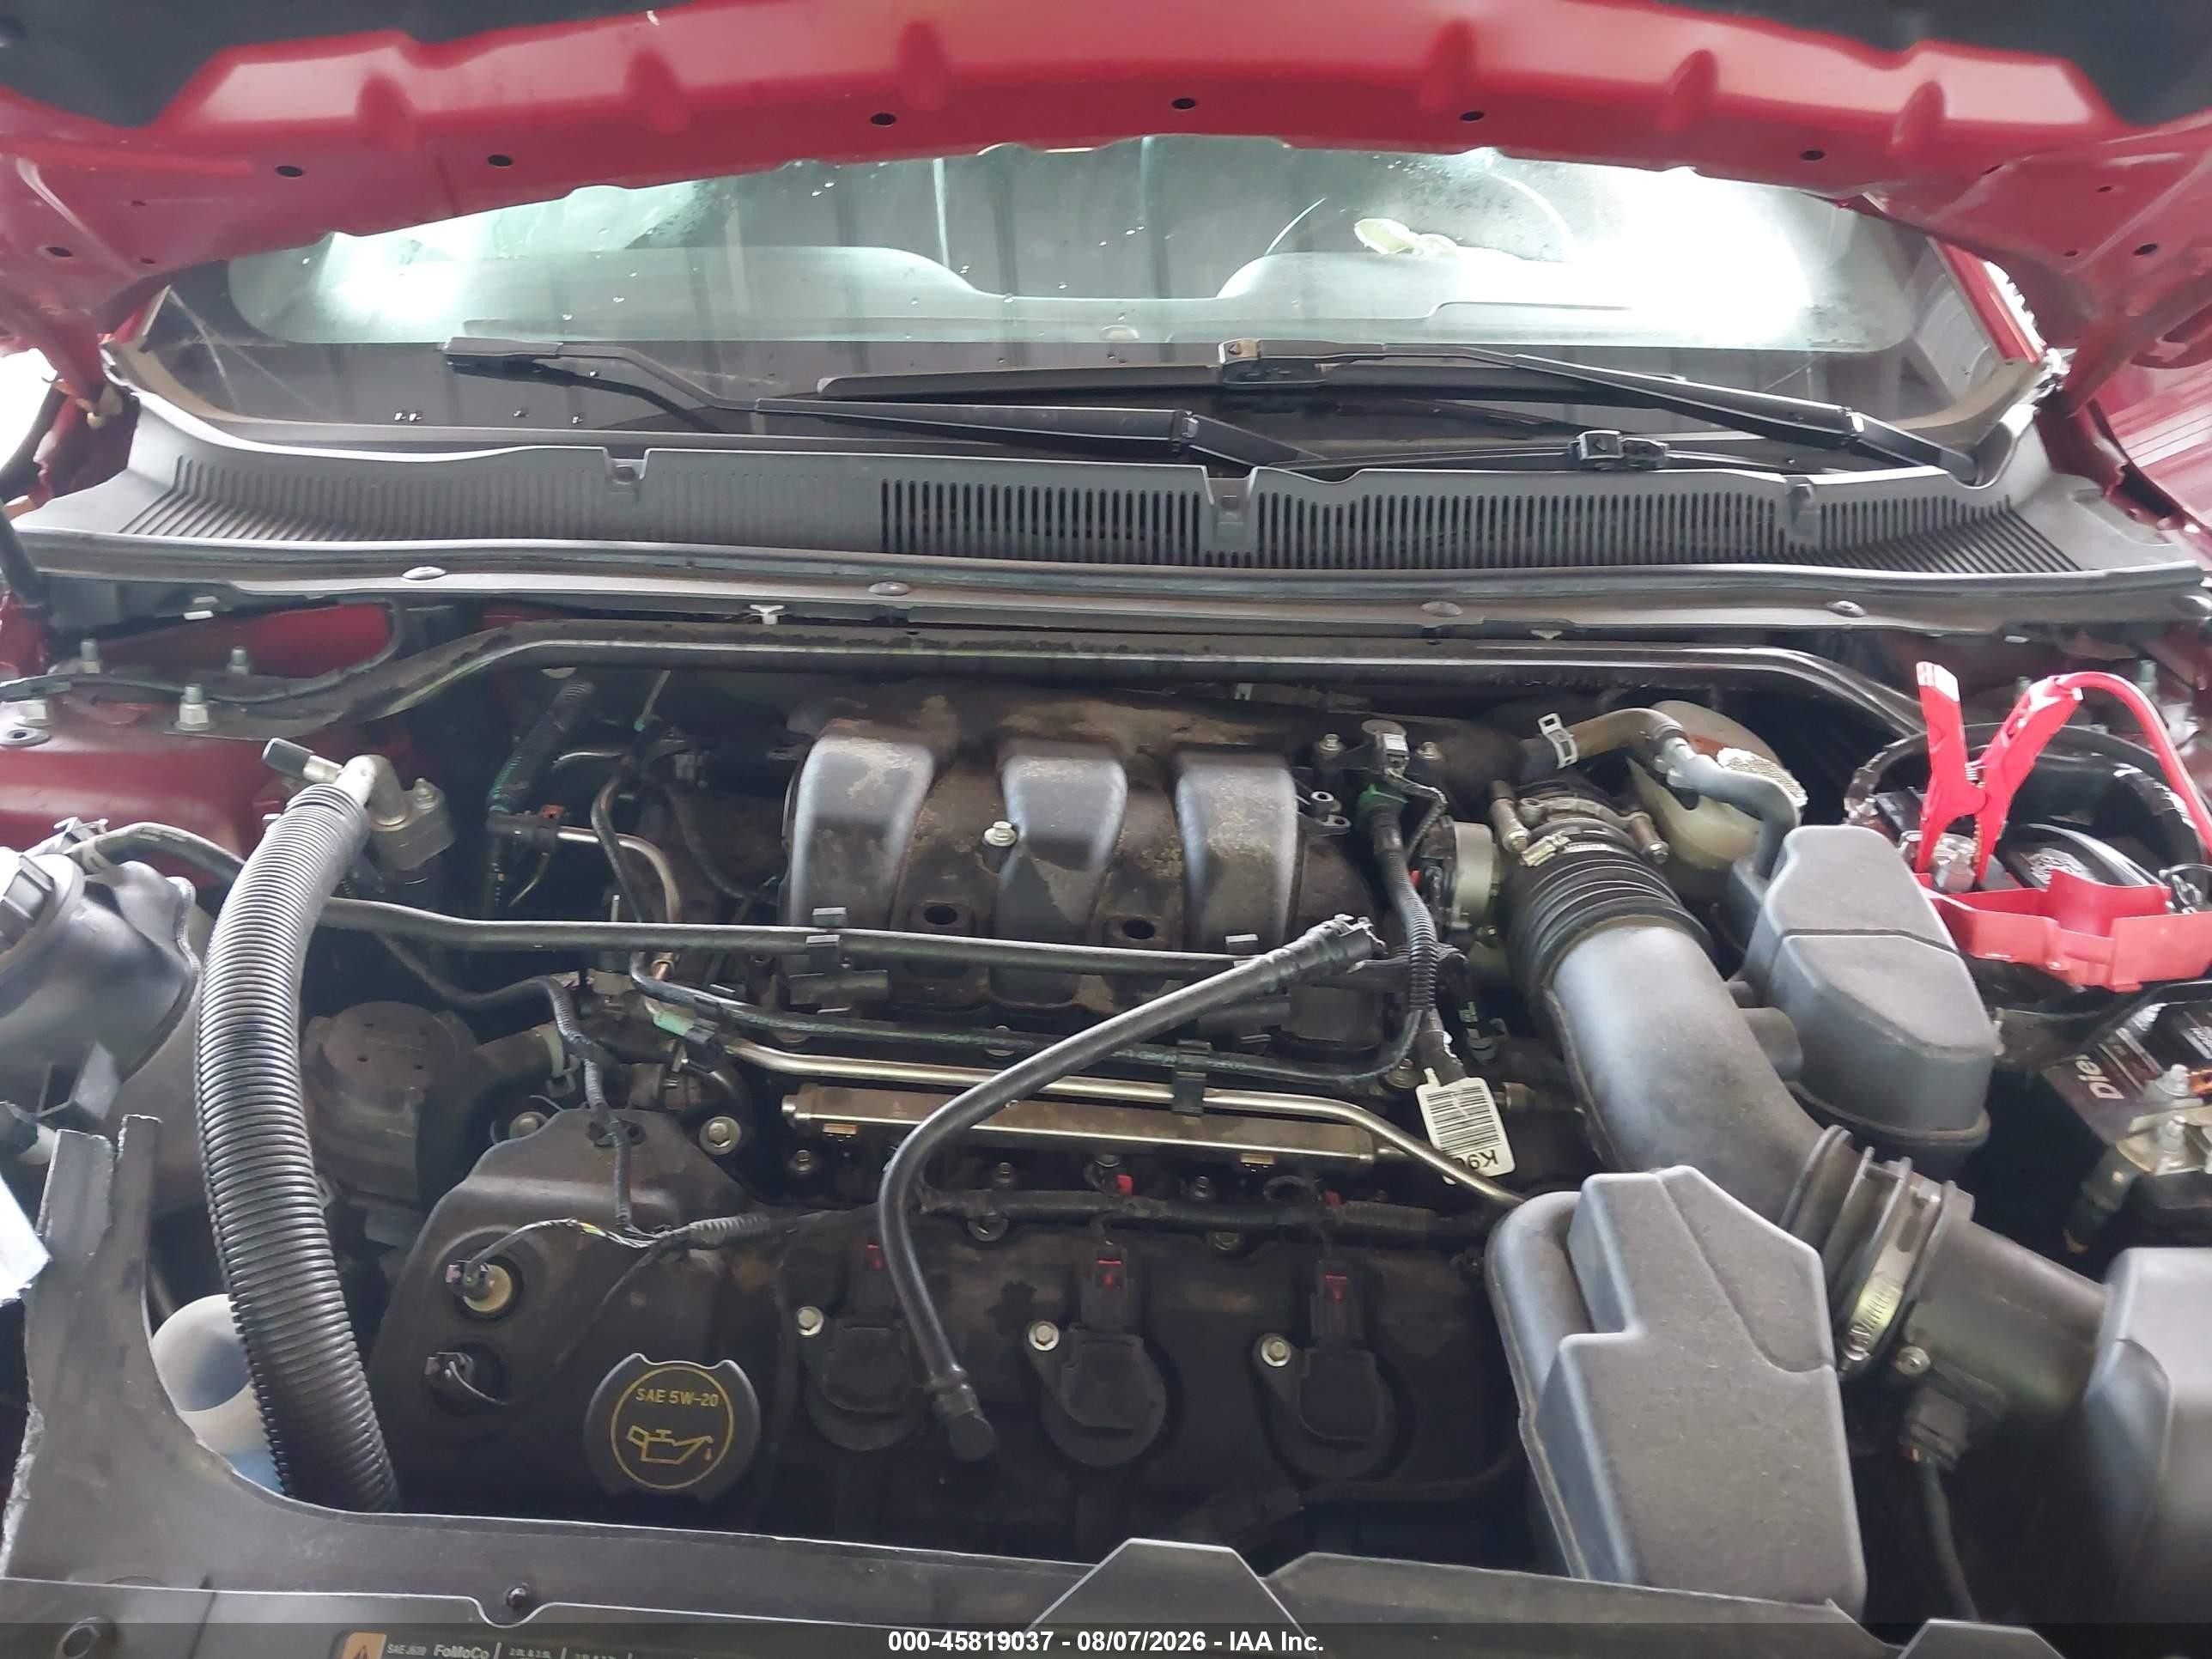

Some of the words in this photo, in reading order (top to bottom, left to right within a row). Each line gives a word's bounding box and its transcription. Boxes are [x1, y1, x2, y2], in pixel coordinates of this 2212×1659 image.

[635, 1388, 666, 1403] SAE
[668, 1389, 719, 1407] 5W-20
[433, 1644, 489, 1659] FoMoCo
